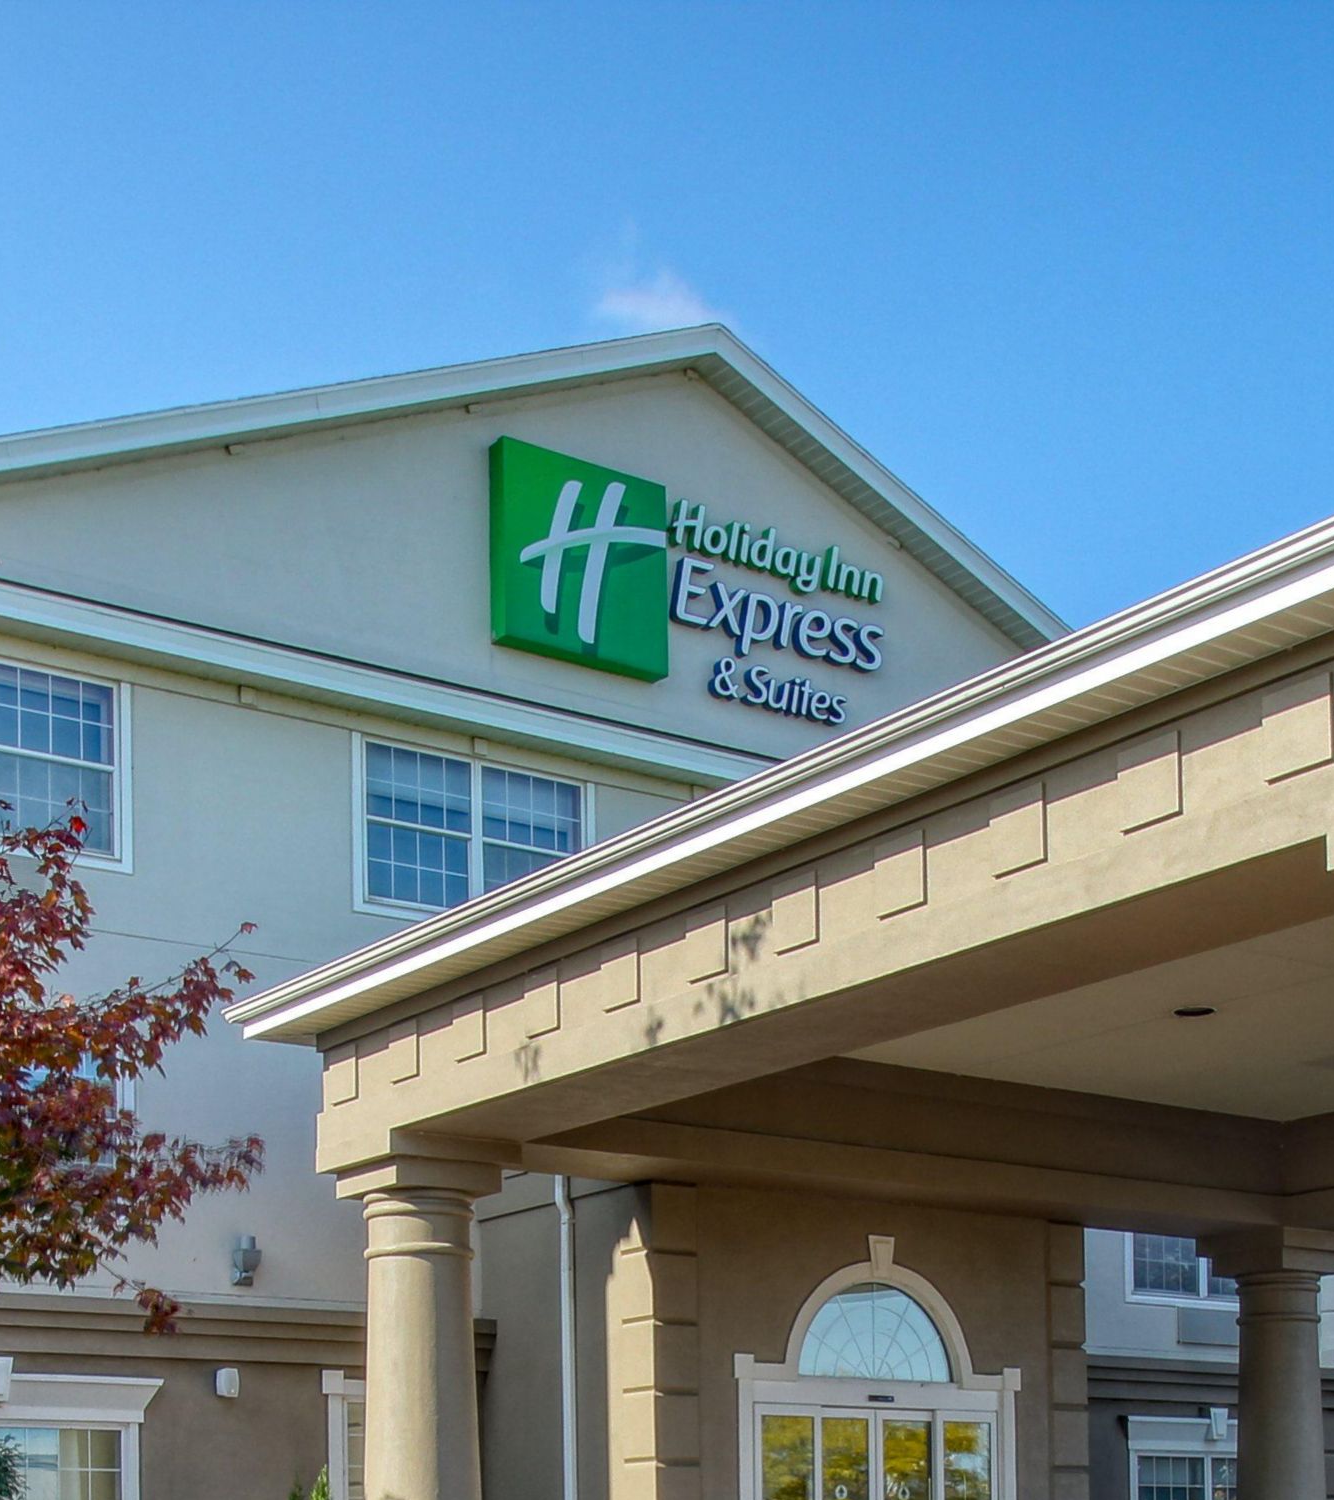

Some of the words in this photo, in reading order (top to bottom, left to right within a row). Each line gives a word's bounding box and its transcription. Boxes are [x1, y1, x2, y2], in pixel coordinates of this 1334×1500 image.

[669, 498, 822, 594] Holiday
[823, 545, 884, 604] Inn
[670, 556, 885, 673] Express
[709, 656, 740, 700] &
[742, 665, 848, 726] Suites
